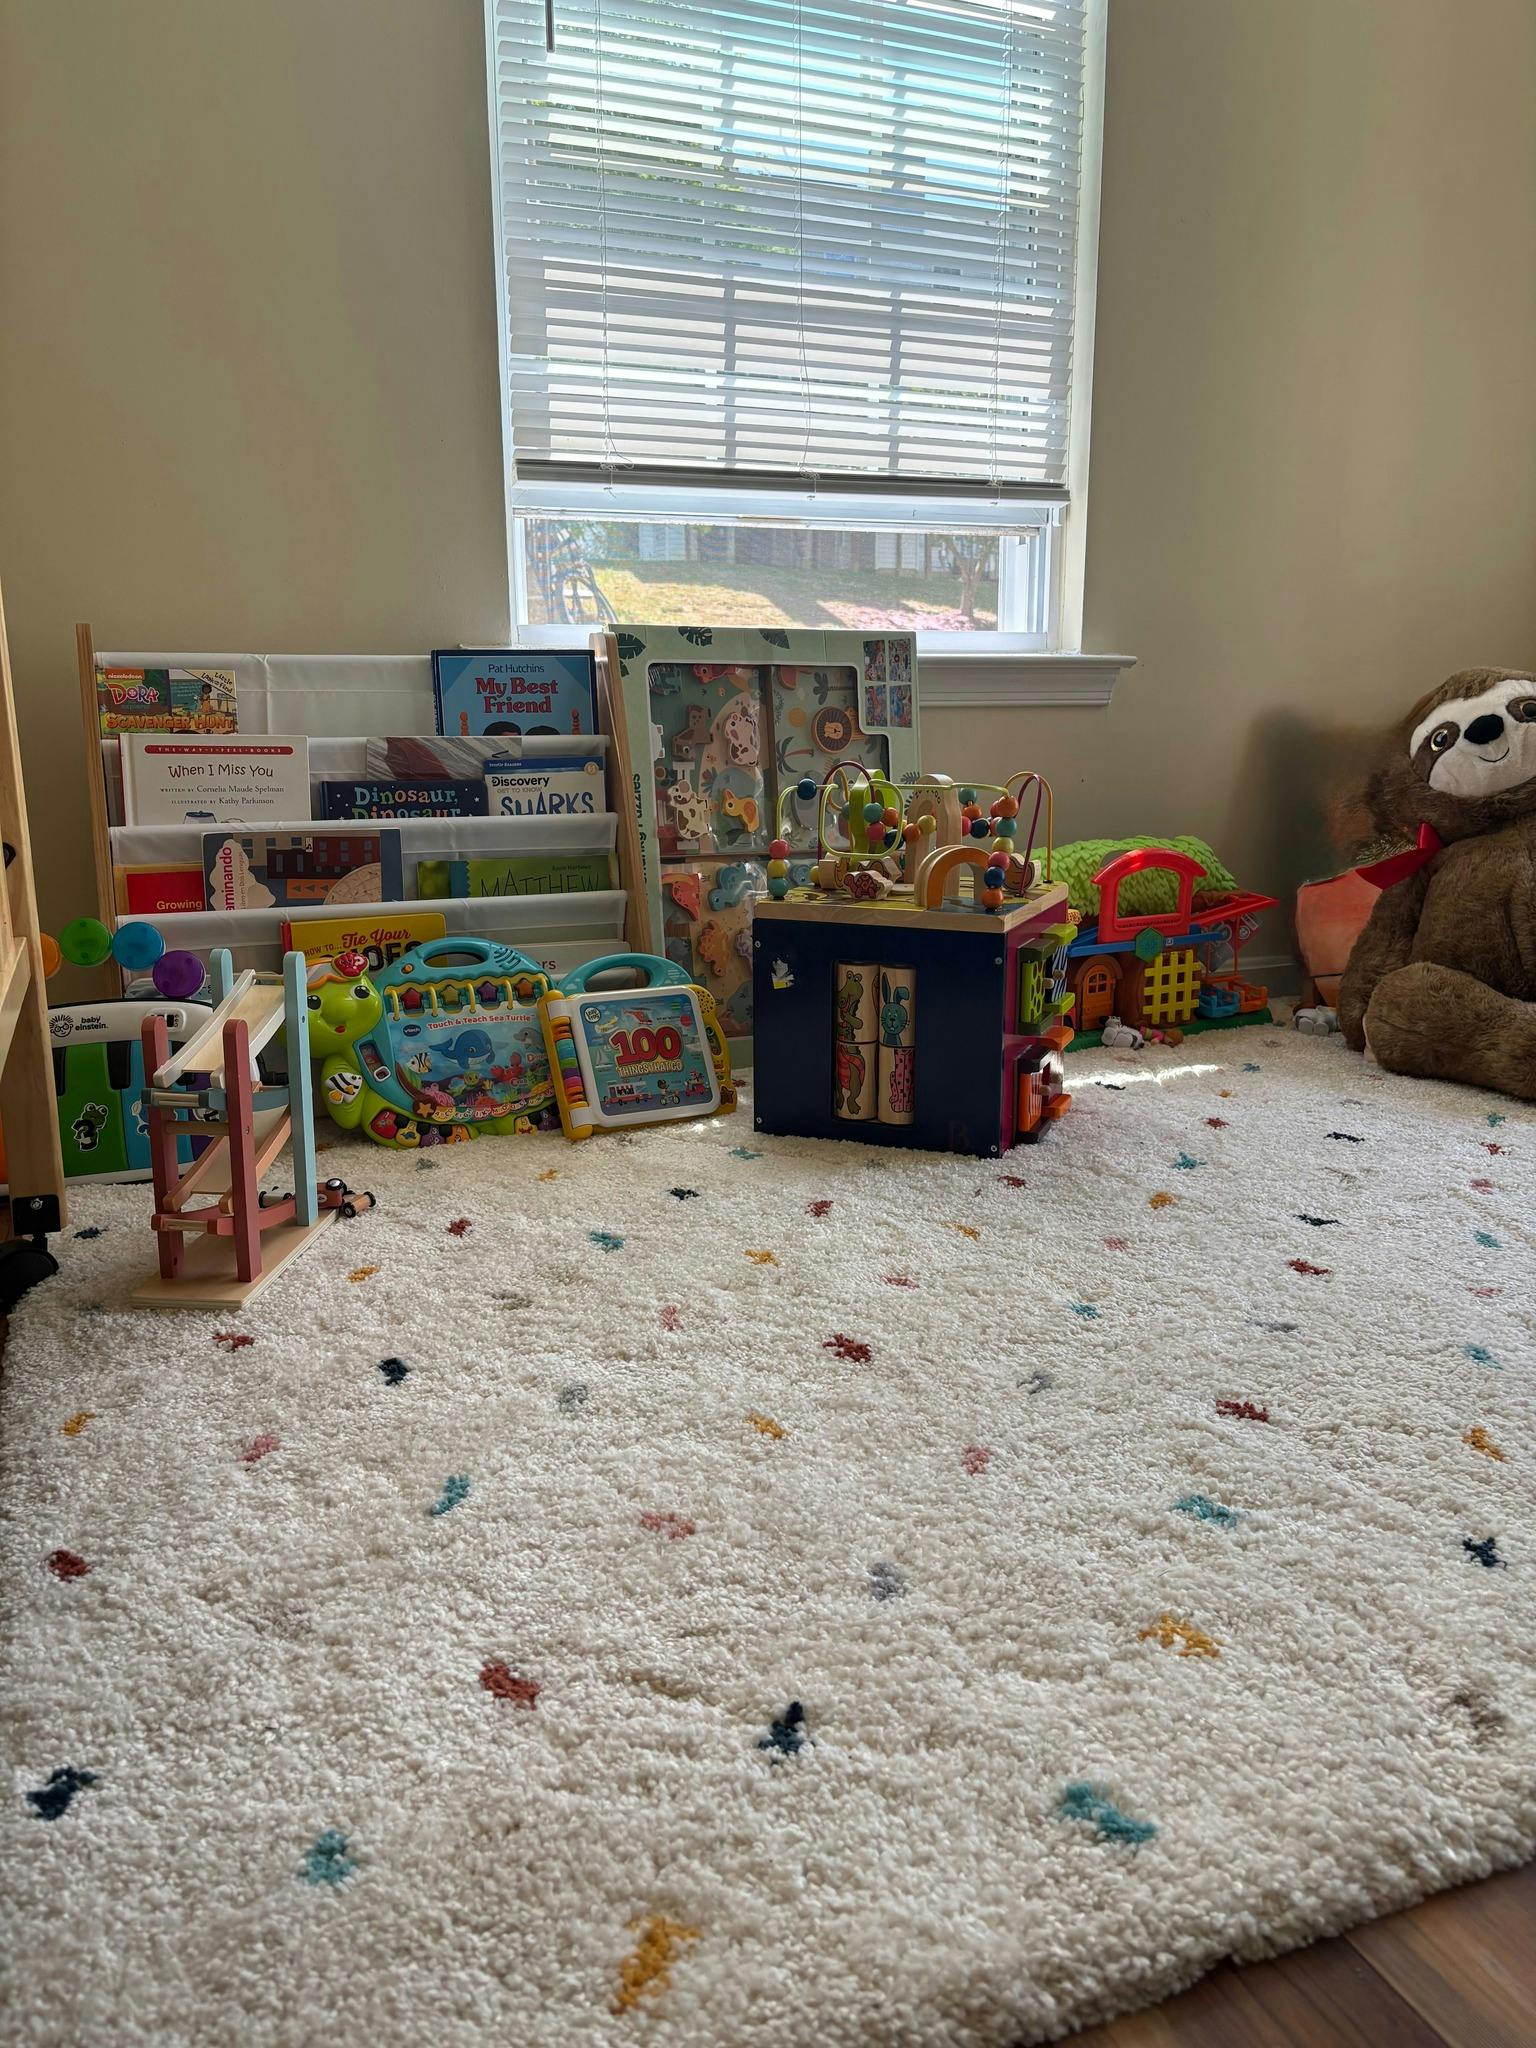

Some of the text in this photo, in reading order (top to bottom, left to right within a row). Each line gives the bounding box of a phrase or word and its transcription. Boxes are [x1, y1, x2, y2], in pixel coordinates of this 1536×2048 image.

[488, 664, 545, 673] Pat Hutchins
[475, 677, 559, 697] My Best
[484, 696, 552, 714] Friend
[105, 711, 235, 729] SCAVENGER HUNT
[168, 763, 274, 778] When I Miss You
[196, 785, 226, 793] Cornelia
[228, 785, 253, 793] Maude
[255, 785, 284, 794] Spelman
[491, 776, 550, 788] Discovery
[218, 797, 239, 806] Kathy
[241, 797, 274, 805] Parkinson
[354, 786, 458, 805] Dinosaur,
[500, 792, 594, 816] SHARKS
[632, 773, 643, 827] uzzles
[480, 869, 599, 897] MATTHEW
[156, 899, 203, 910] Growing
[342, 928, 411, 948] Tie Your
[81, 1016, 101, 1024] baby
[428, 1019, 454, 1030] Touch
[455, 1018, 462, 1026] &
[463, 1015, 488, 1025] Teach
[489, 1014, 505, 1023] Sea
[609, 1026, 683, 1066] 100
[616, 1063, 649, 1078] THINGS
[671, 1059, 683, 1071] GO
